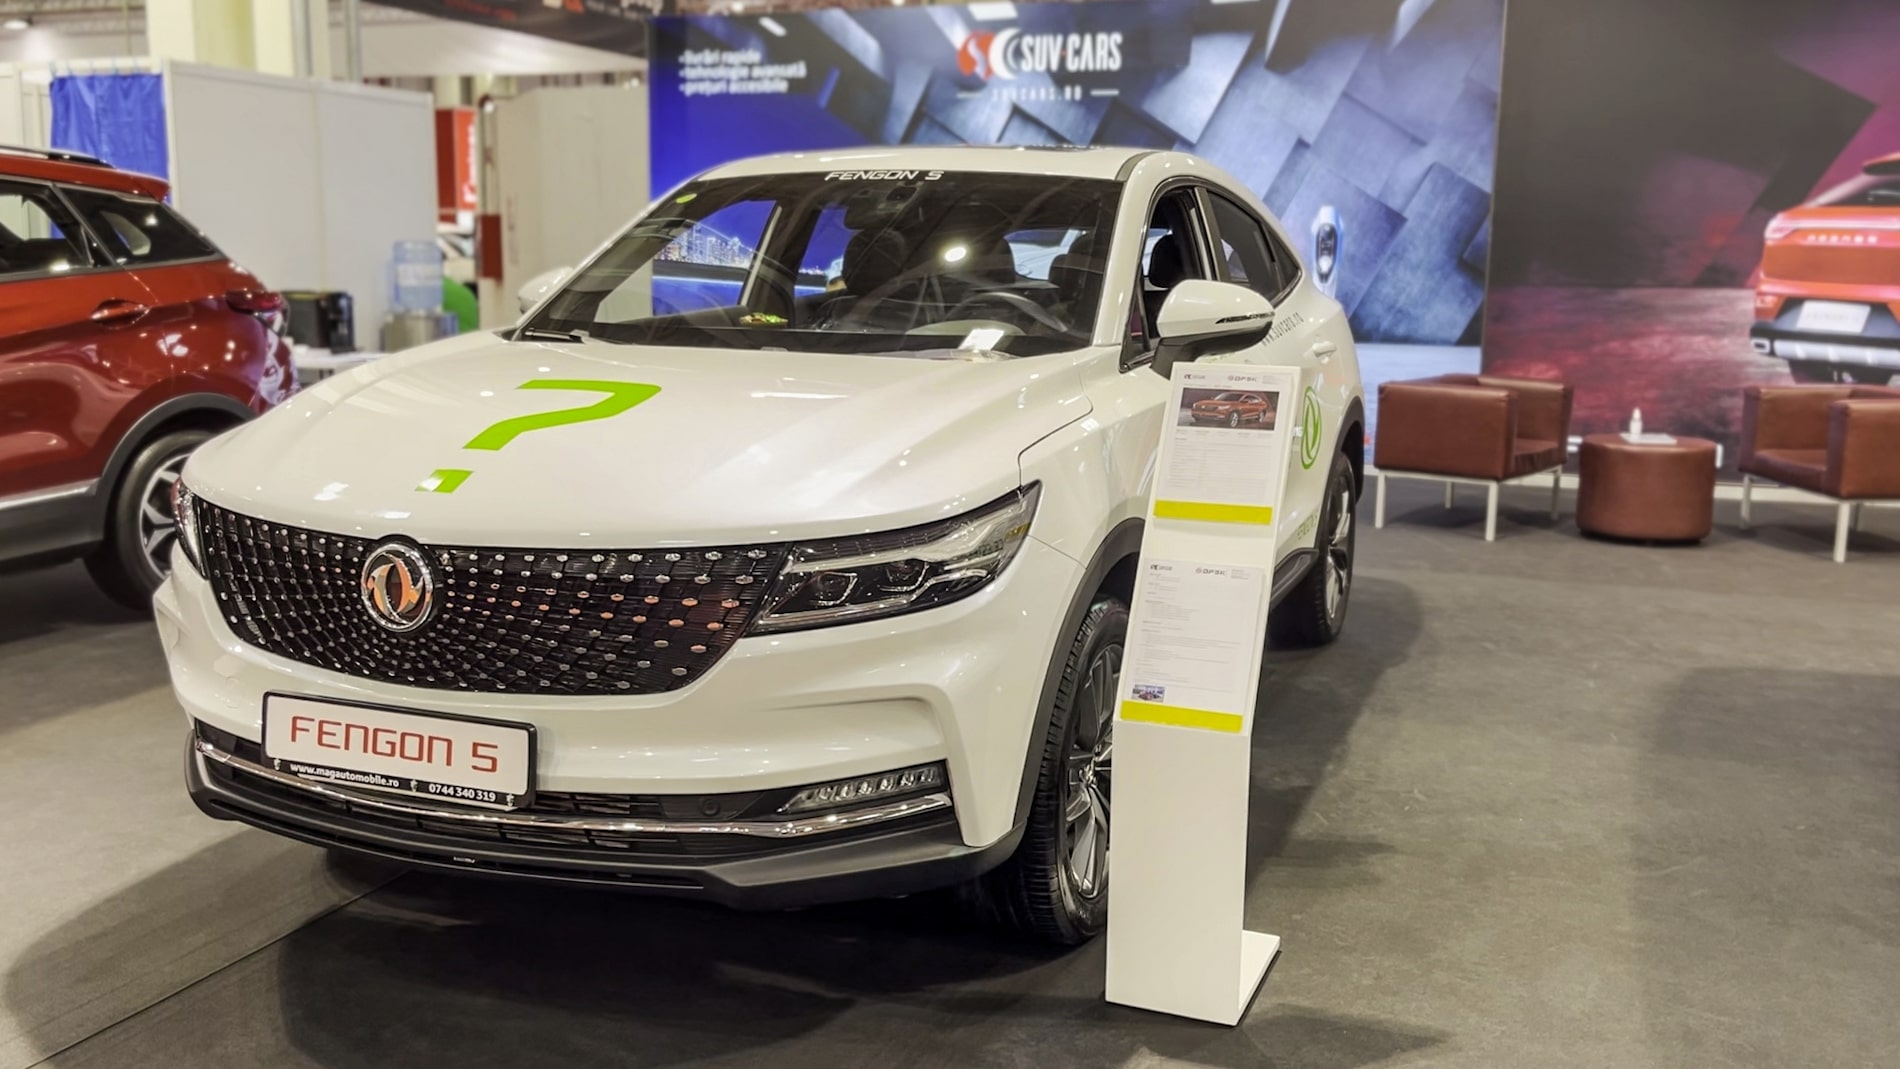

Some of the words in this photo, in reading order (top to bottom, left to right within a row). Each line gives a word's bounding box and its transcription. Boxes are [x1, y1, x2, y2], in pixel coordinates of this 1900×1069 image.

[824, 169, 919, 181] FENGON
[290, 715, 453, 767] FENGON
[471, 741, 498, 773] 5
[290, 762, 399, 788] www.magautomobile.ro
[428, 783, 454, 797] 0744
[455, 785, 475, 799] 340
[476, 788, 496, 802] 319
